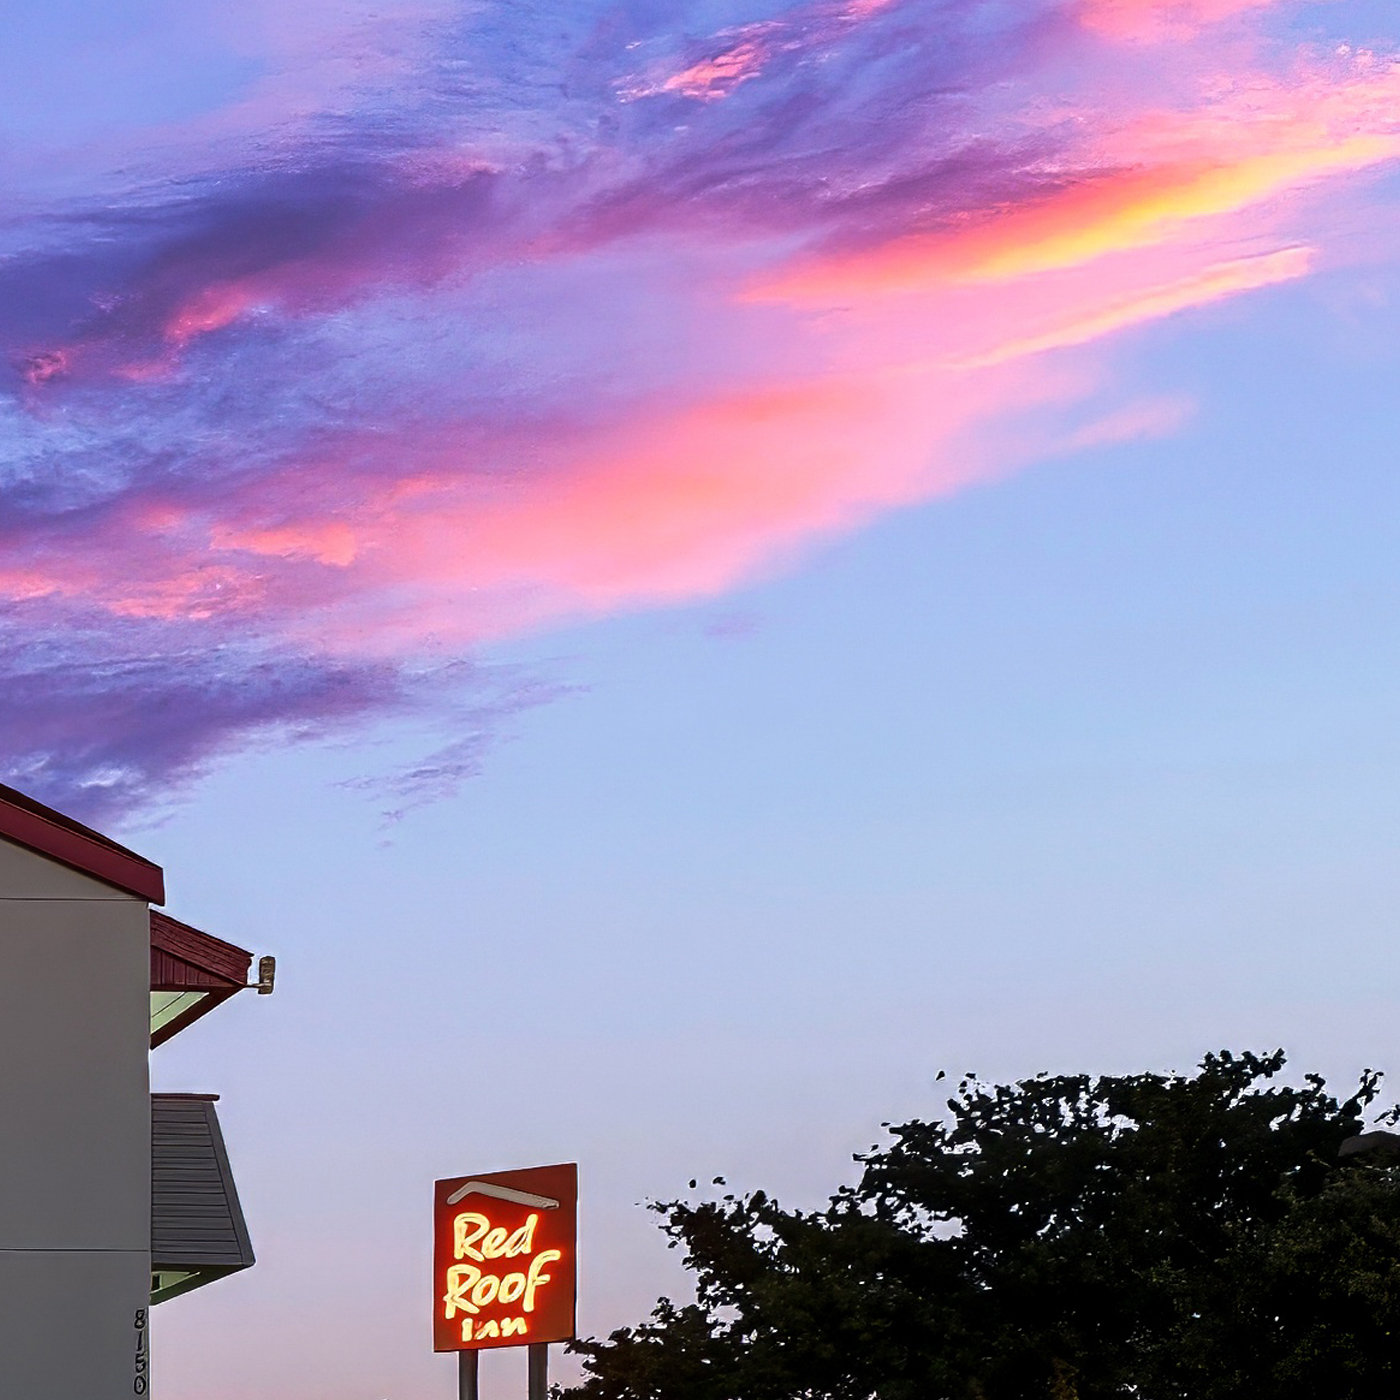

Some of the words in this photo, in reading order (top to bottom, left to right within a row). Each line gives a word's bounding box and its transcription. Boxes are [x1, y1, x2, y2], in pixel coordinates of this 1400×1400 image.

[453, 1212, 539, 1262] Red
[443, 1249, 561, 1320] Roof
[461, 1317, 529, 1342] Inn
